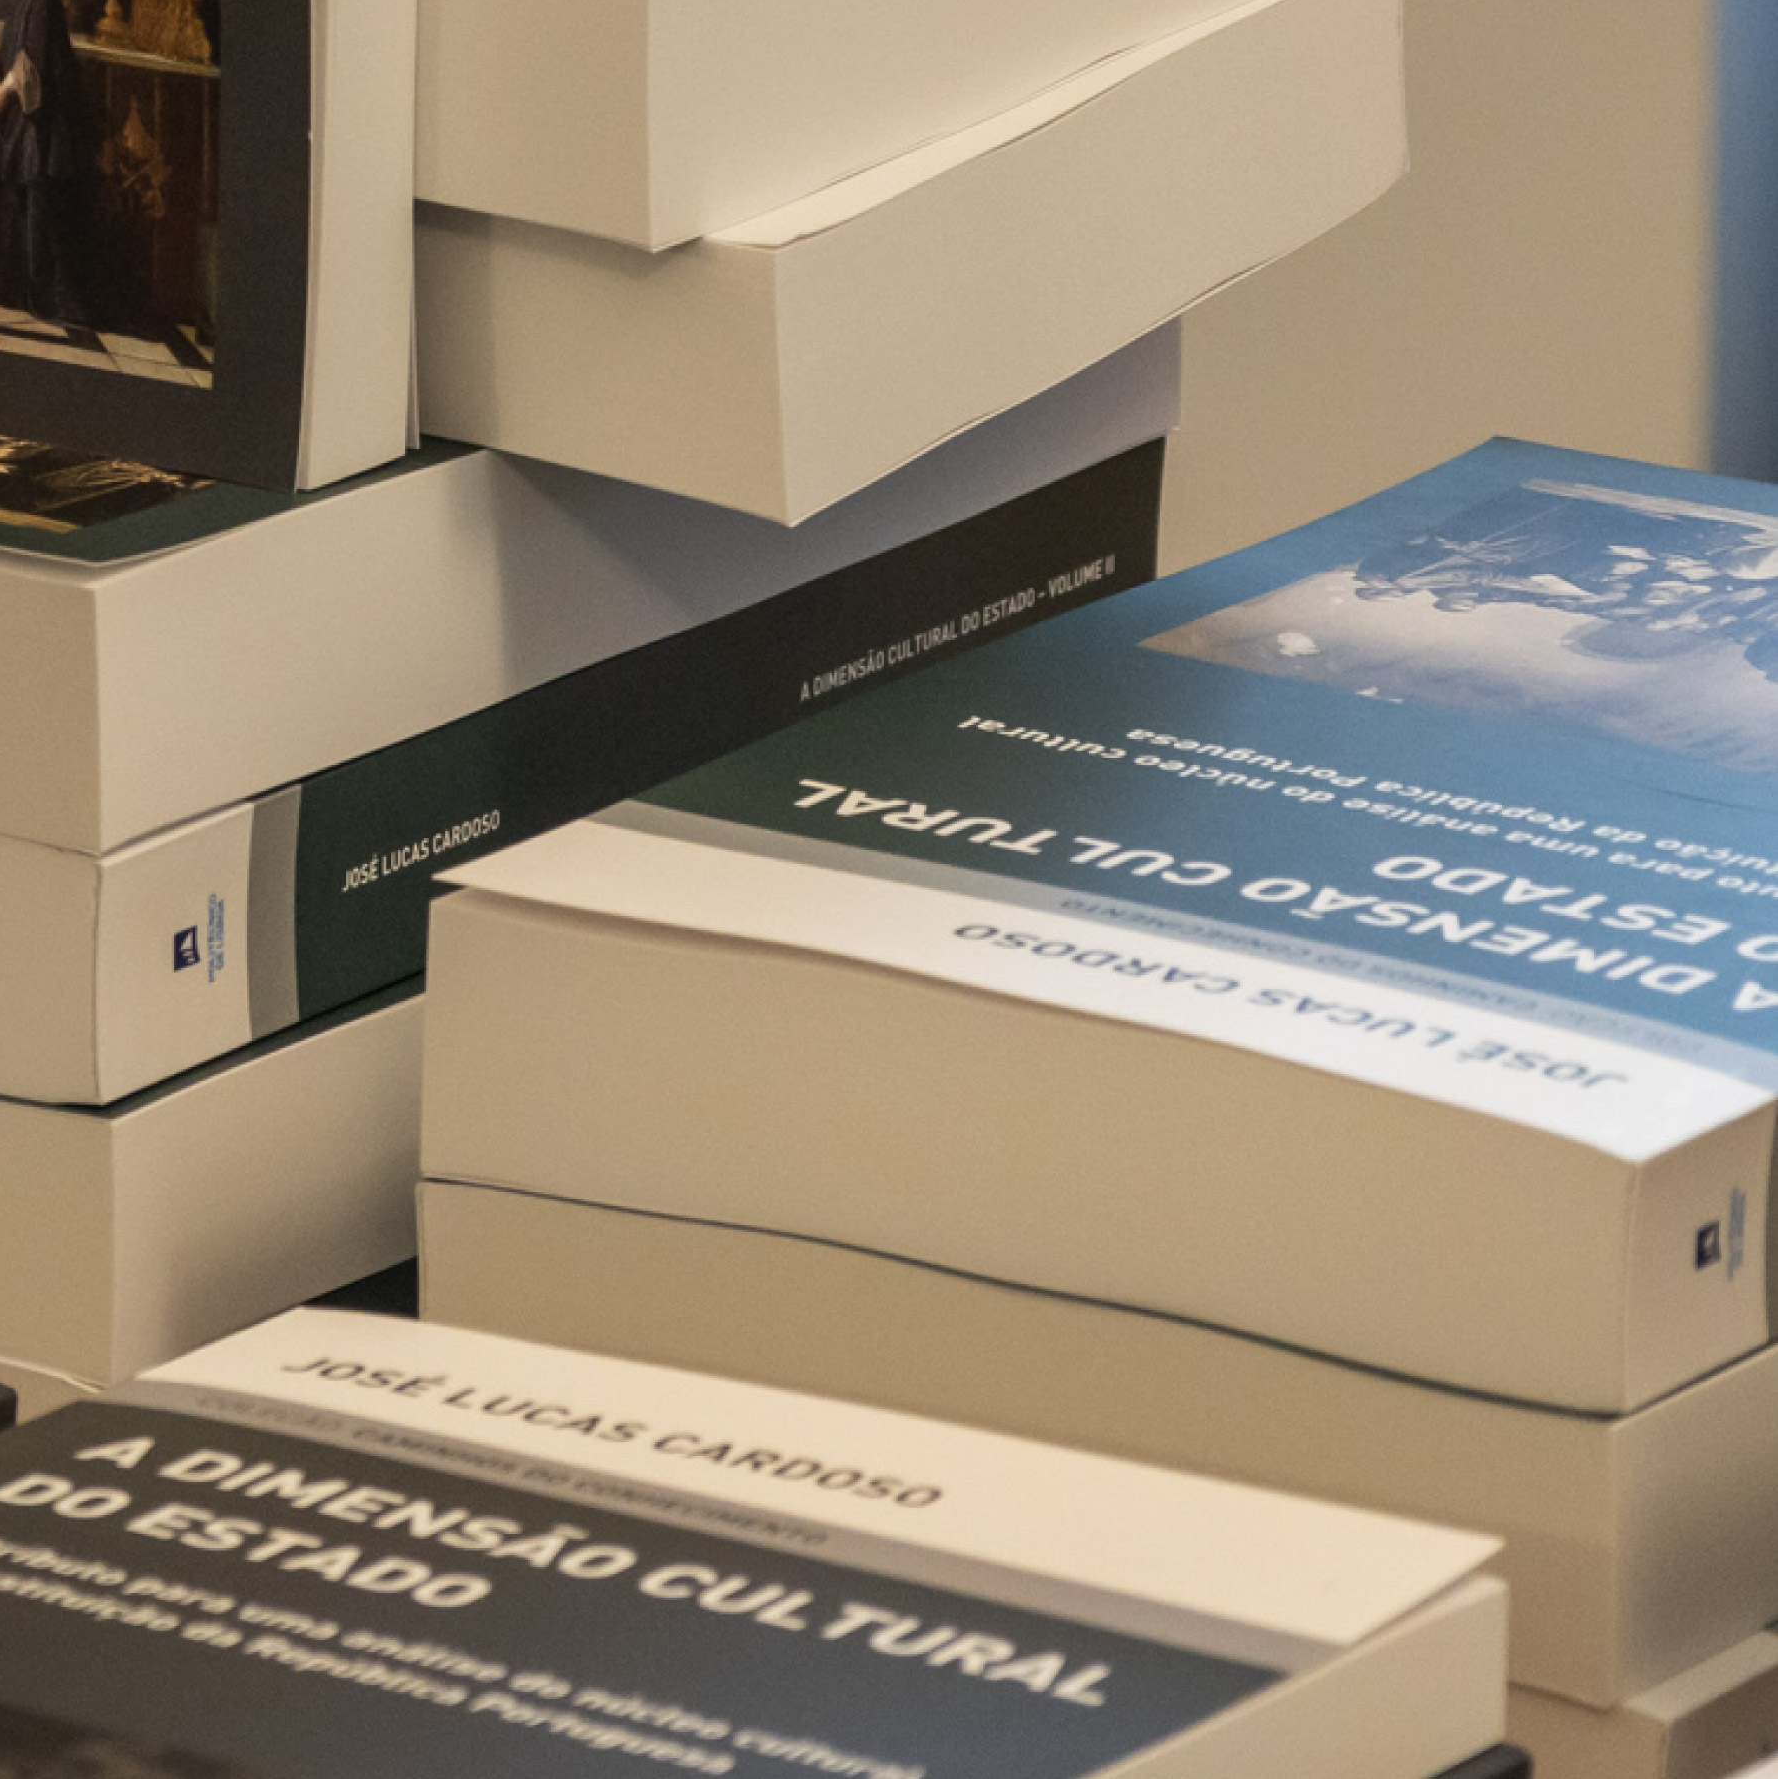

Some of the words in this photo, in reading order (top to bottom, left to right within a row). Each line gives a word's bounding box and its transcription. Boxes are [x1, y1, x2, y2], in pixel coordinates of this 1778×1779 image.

[800, 679, 811, 702] A
[813, 649, 885, 698] DIMENSÃO
[888, 621, 957, 666] CULTURAL
[961, 611, 979, 635] DO
[982, 588, 1035, 627] ESTADO
[1048, 558, 1102, 598] VOLUME
[957, 715, 1127, 759] cultural
[1127, 728, 1367, 788] Portuguesa
[1134, 754, 1275, 791] núcleo
[1282, 784, 1335, 803] do
[794, 777, 1232, 886] CULTURAL
[1342, 797, 1498, 836] análise
[1375, 780, 1585, 832] República
[1594, 825, 1646, 842] da
[341, 852, 378, 893] JOSÉ
[382, 837, 430, 876] LUCAS
[432, 809, 500, 855] CARDOSO
[1505, 831, 1599, 857] uma
[1608, 851, 1714, 880] para
[1372, 855, 1732, 944] ESTADO
[953, 924, 1240, 995] CARDOSO
[1241, 877, 1717, 995] DIMENSÃO
[1248, 987, 1456, 1048] LUCAS
[1457, 1039, 1628, 1088] JOSÉ
[279, 1356, 448, 1397] JOSÉ
[441, 1385, 647, 1444] LUCAS
[651, 1431, 945, 1510] CARDOSO
[72, 1435, 156, 1470] A
[156, 1447, 638, 1580] DIMENSÃO
[638, 1562, 1113, 1708] CULTURAL
[125, 1502, 492, 1609] ESTADO
